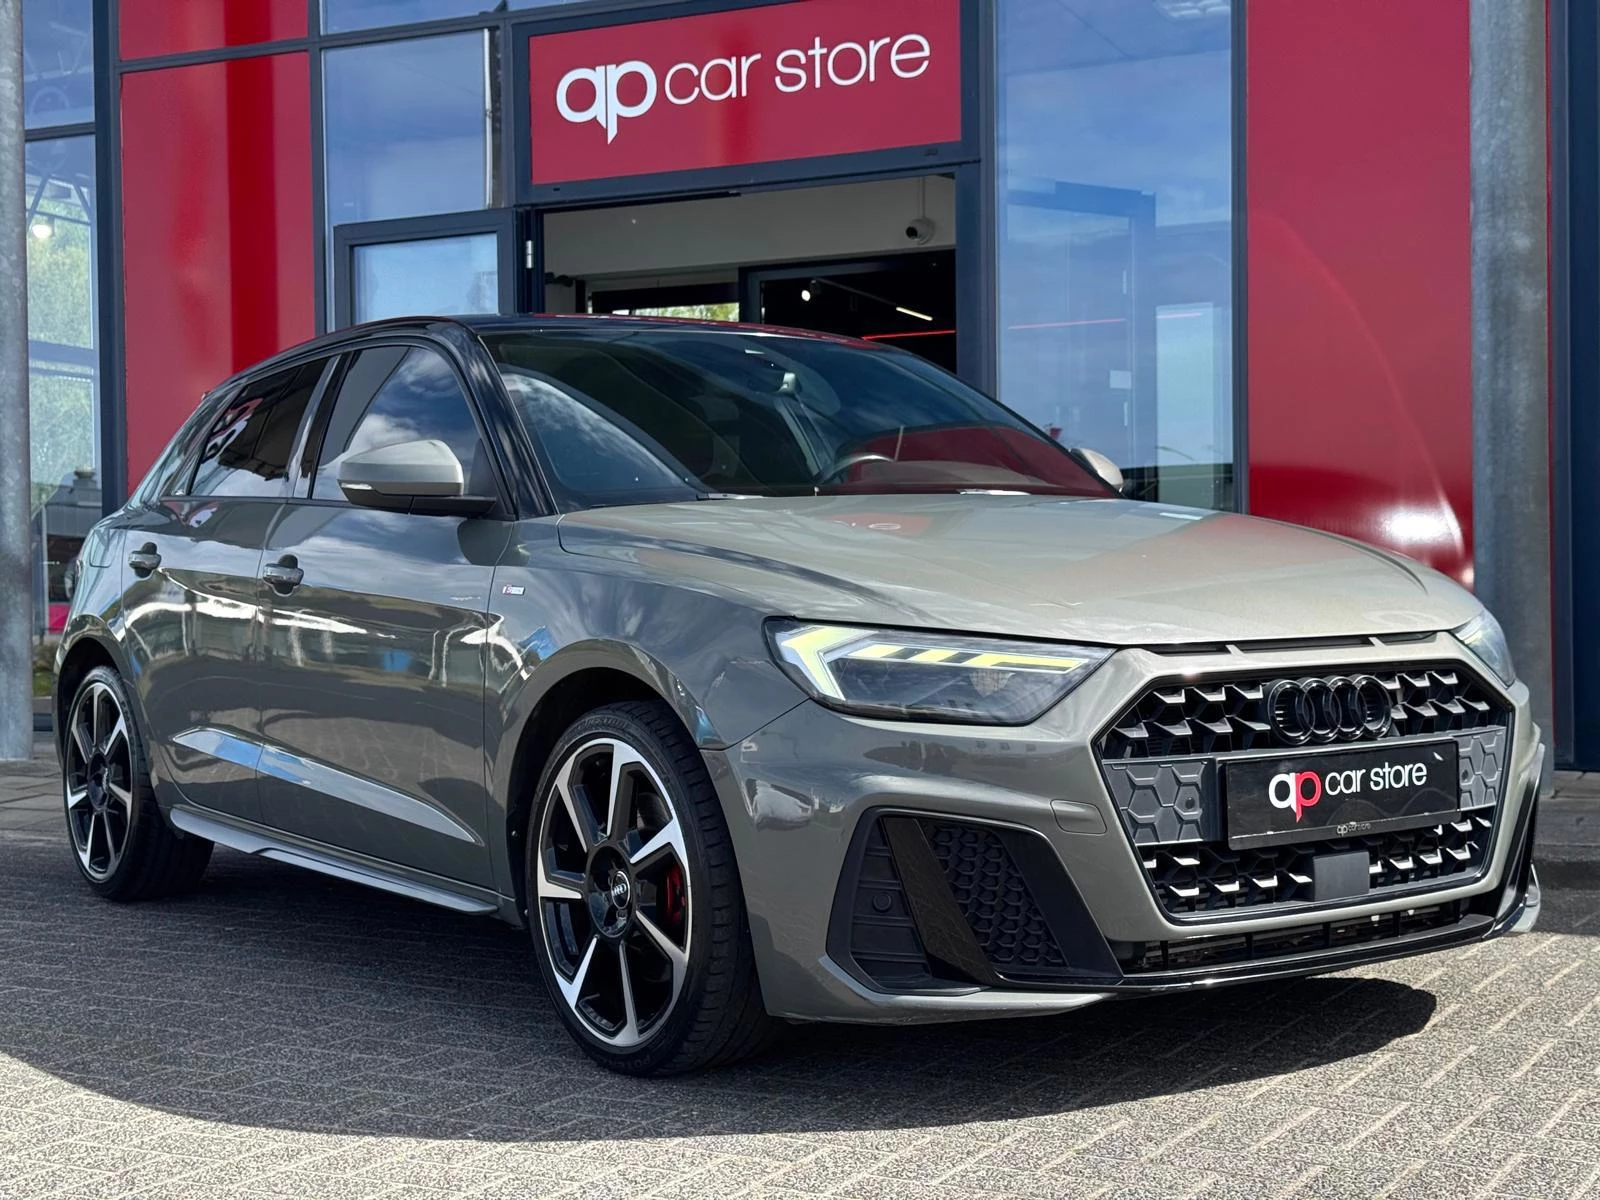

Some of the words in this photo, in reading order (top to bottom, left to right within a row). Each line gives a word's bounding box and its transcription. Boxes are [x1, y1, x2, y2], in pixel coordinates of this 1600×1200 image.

[664, 53, 761, 105] car
[775, 33, 931, 93] store
[1325, 769, 1366, 796] car
[1370, 762, 1427, 791] store
